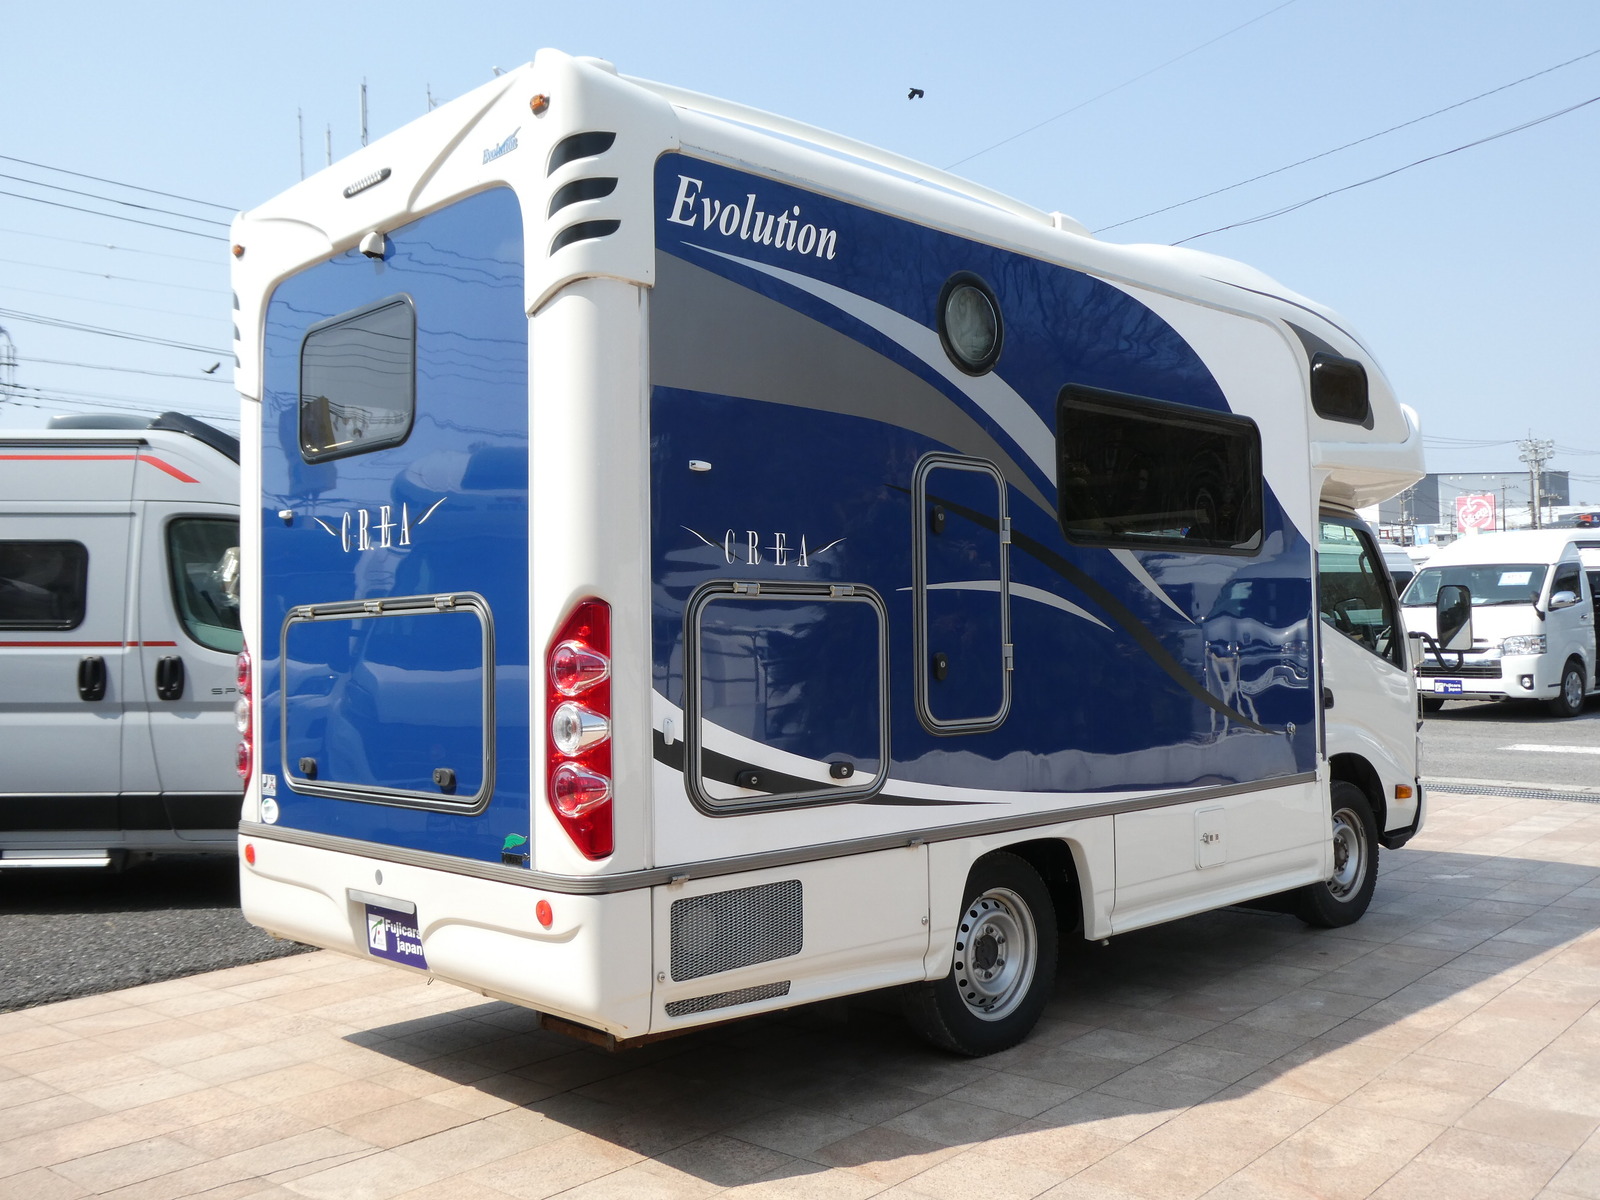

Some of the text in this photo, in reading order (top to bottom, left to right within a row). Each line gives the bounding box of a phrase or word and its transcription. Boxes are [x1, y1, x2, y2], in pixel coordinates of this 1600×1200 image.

[666, 174, 838, 260] Evolution
[341, 502, 411, 553] CREA
[724, 528, 809, 568] CREA
[385, 919, 421, 940] Fujicars
